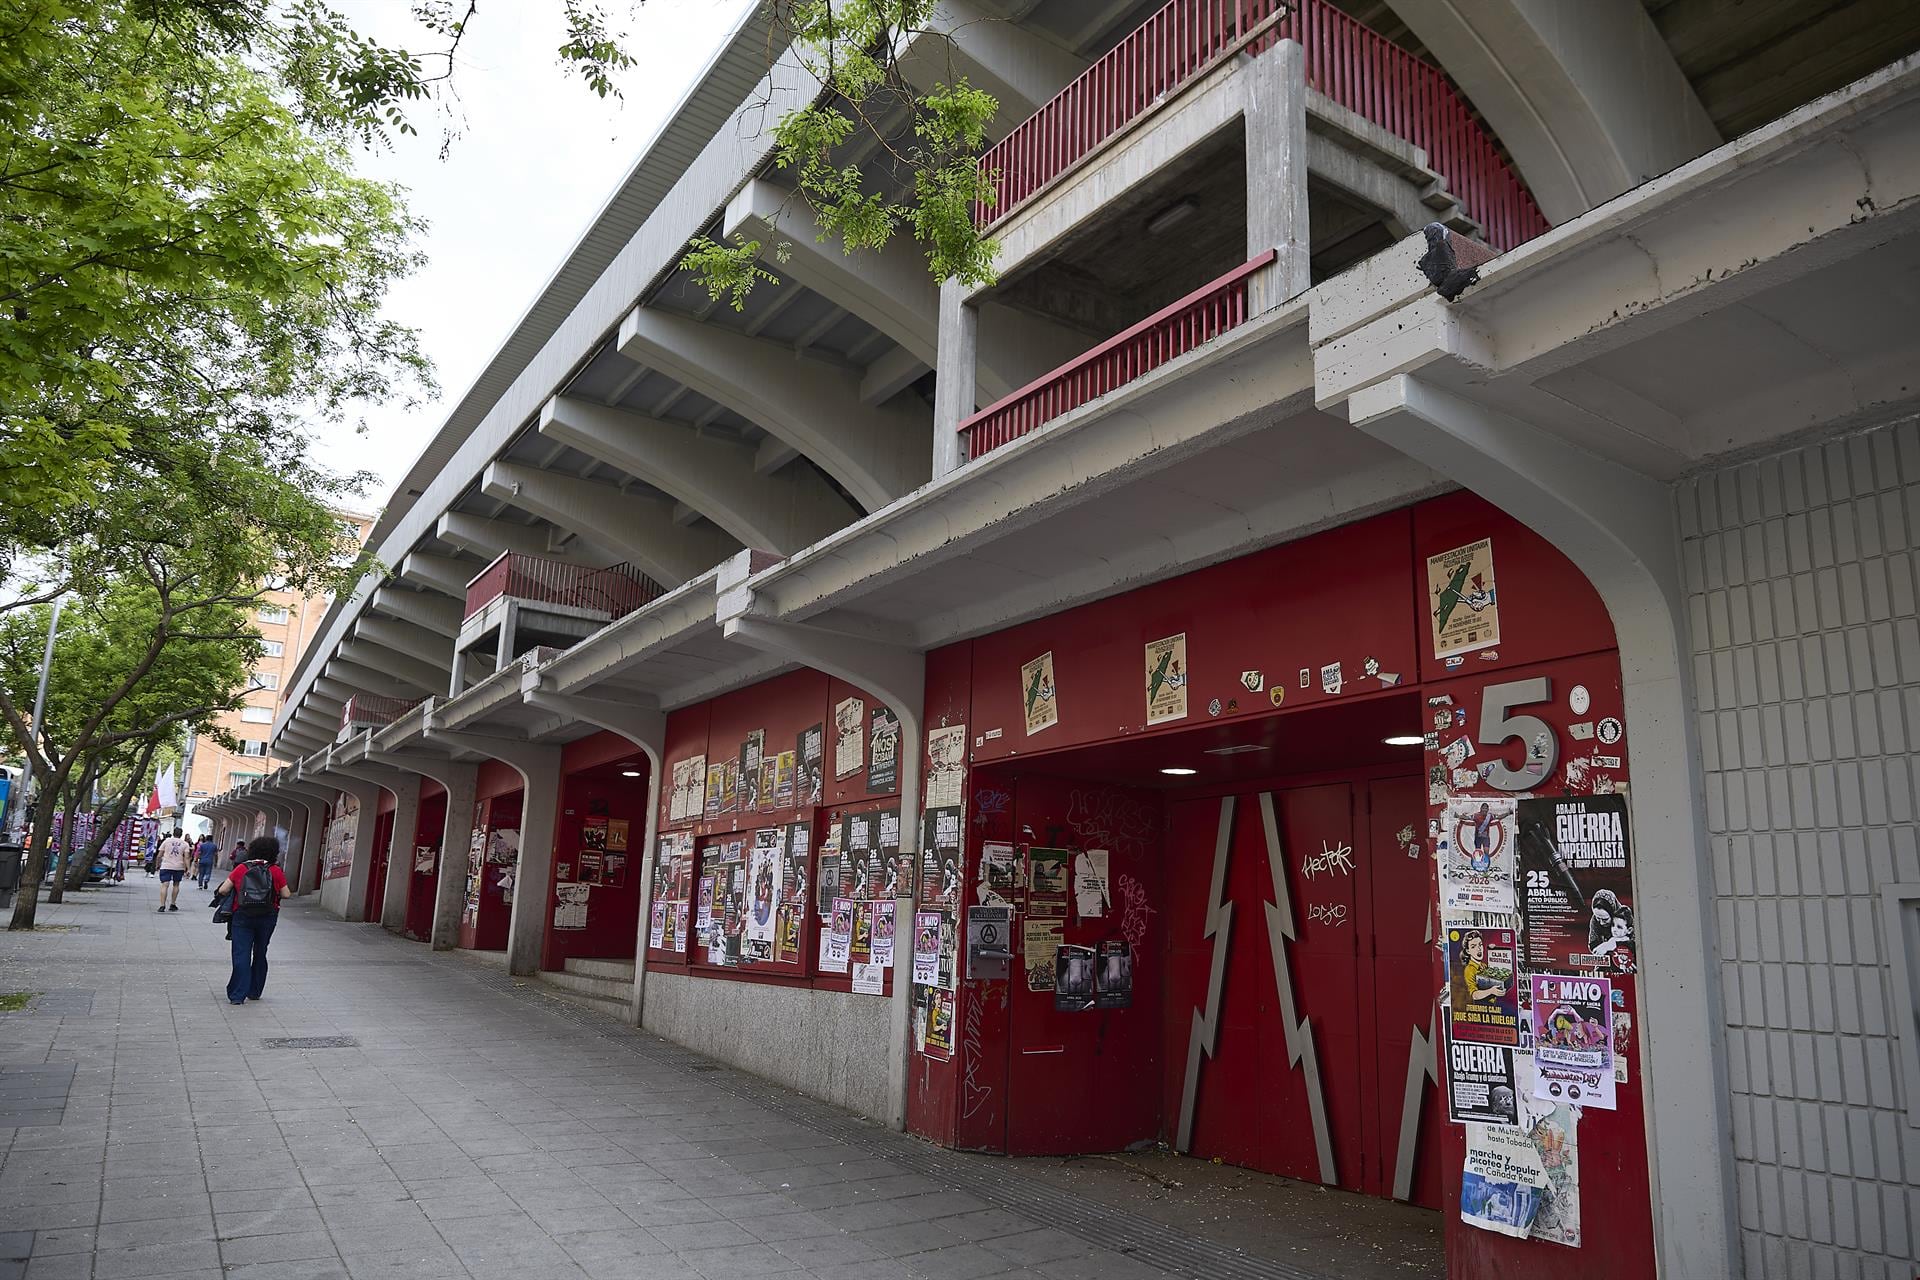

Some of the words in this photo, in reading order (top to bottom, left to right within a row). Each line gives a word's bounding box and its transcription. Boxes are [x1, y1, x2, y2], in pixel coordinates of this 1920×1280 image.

[1477, 676, 1559, 791] 5
[875, 737, 892, 752] NOS
[1556, 803, 1577, 815] ABAJO
[1577, 803, 1586, 814] LA
[1556, 812, 1624, 843] GUERRA
[1557, 842, 1625, 860] IMPERIALISTA
[1592, 860, 1596, 868] Y
[1468, 877, 1490, 885] 2026
[1526, 870, 1550, 888] 25
[1560, 981, 1602, 1001] MAYO
[1467, 1013, 1481, 1022] SIGA
[1482, 1014, 1490, 1023] LA
[1491, 1015, 1516, 1026] HUELGA!
[1451, 1044, 1507, 1074] GUERRA
[1453, 1071, 1466, 1081] Abajo
[1466, 1072, 1480, 1082] Trump
[1482, 1073, 1488, 1082] el
[1487, 1125, 1496, 1133] de
[1498, 1127, 1520, 1137] Metro
[1487, 1133, 1505, 1144] hasta
[1469, 1148, 1503, 1161] marcha
[1504, 1155, 1512, 1165] y
[1469, 1156, 1502, 1169] picoteo
[1504, 1163, 1541, 1177] popular
[1473, 1167, 1484, 1175] en
[1486, 1166, 1517, 1181] Cañada
[1518, 1174, 1536, 1185] Real
